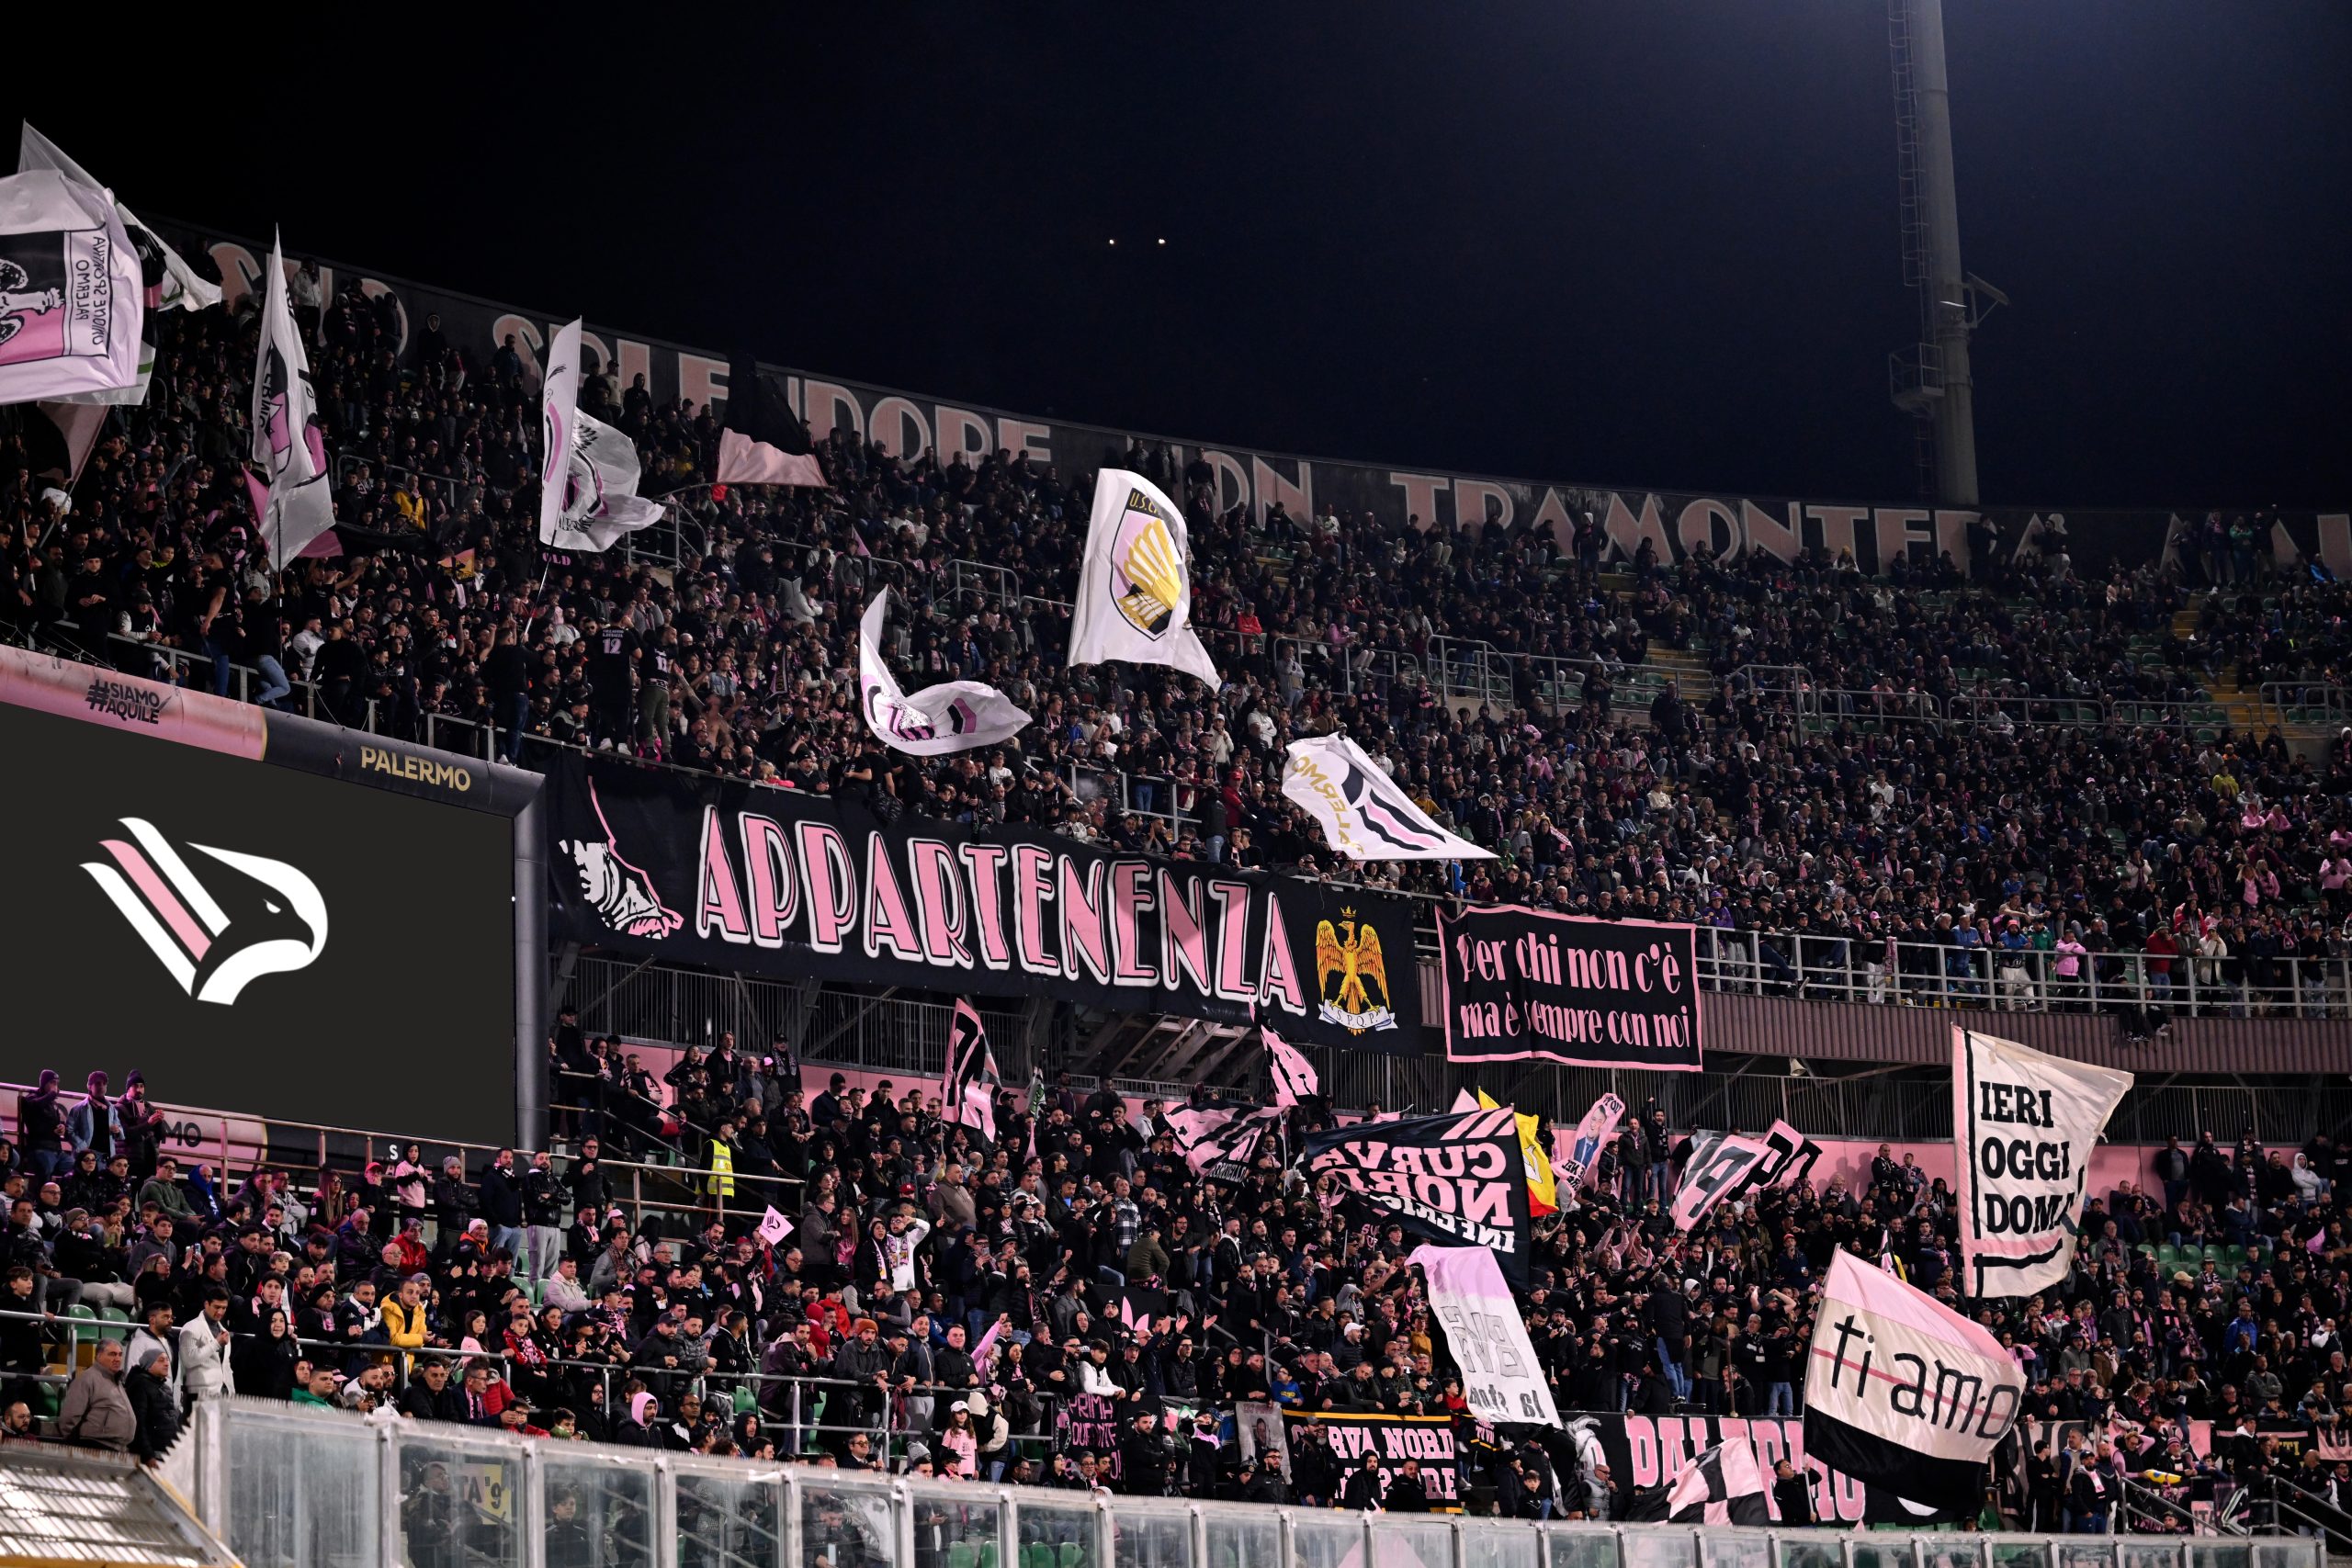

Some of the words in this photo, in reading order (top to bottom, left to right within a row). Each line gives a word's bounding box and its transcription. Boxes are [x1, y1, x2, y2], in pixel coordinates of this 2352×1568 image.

[492, 313, 1052, 470] SPLEDORE
[603, 637, 622, 655] 12
[85, 680, 161, 711] #SIAMO
[105, 699, 161, 725] AQUILE
[360, 746, 471, 792] PALERMO
[695, 803, 1306, 1017] APPARTENENZA
[1456, 931, 1508, 983] Per
[1516, 931, 1562, 987] chi
[1567, 946, 1630, 991] non
[1460, 1000, 1500, 1039] ma
[1505, 991, 1521, 1037] è
[1523, 998, 1604, 1044] sempre
[1608, 1010, 1649, 1047] con
[1653, 1005, 1690, 1048] noi
[1979, 1081, 2054, 1128] IERI
[1981, 1136, 2070, 1181] OGGI
[1832, 1314, 1875, 1399] ti
[1890, 1351, 2020, 1440] amo
[1291, 1425, 1380, 1460] CRVA
[1382, 1427, 1455, 1460] NORD
